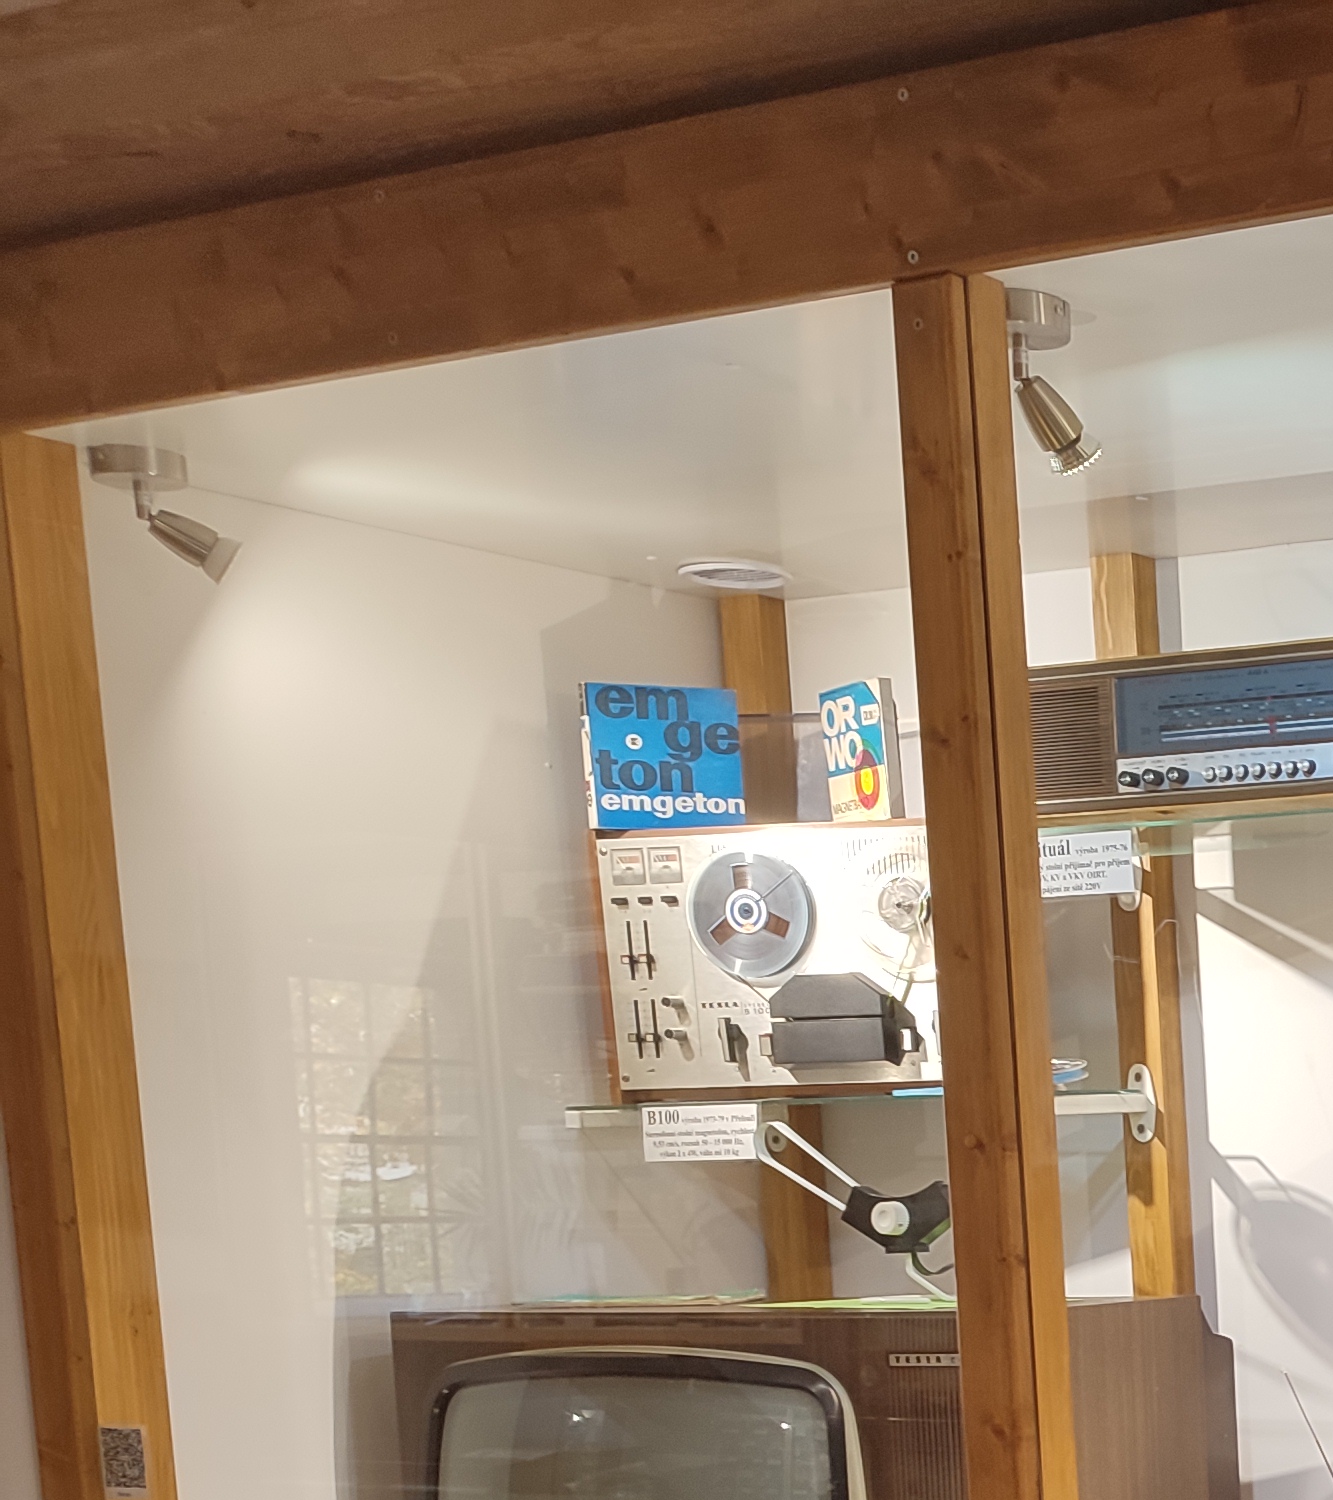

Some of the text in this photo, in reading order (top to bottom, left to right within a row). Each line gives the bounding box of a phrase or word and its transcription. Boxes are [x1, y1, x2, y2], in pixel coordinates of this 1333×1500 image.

[595, 684, 688, 720] em
[821, 696, 858, 736] OR
[664, 720, 740, 762] ge
[823, 731, 863, 771] WO
[596, 749, 694, 792] ton
[600, 792, 746, 818] emgeton
[1038, 840, 1071, 857] tuál
[647, 1110, 679, 1125] B100
[894, 1355, 943, 1365] TESLA
